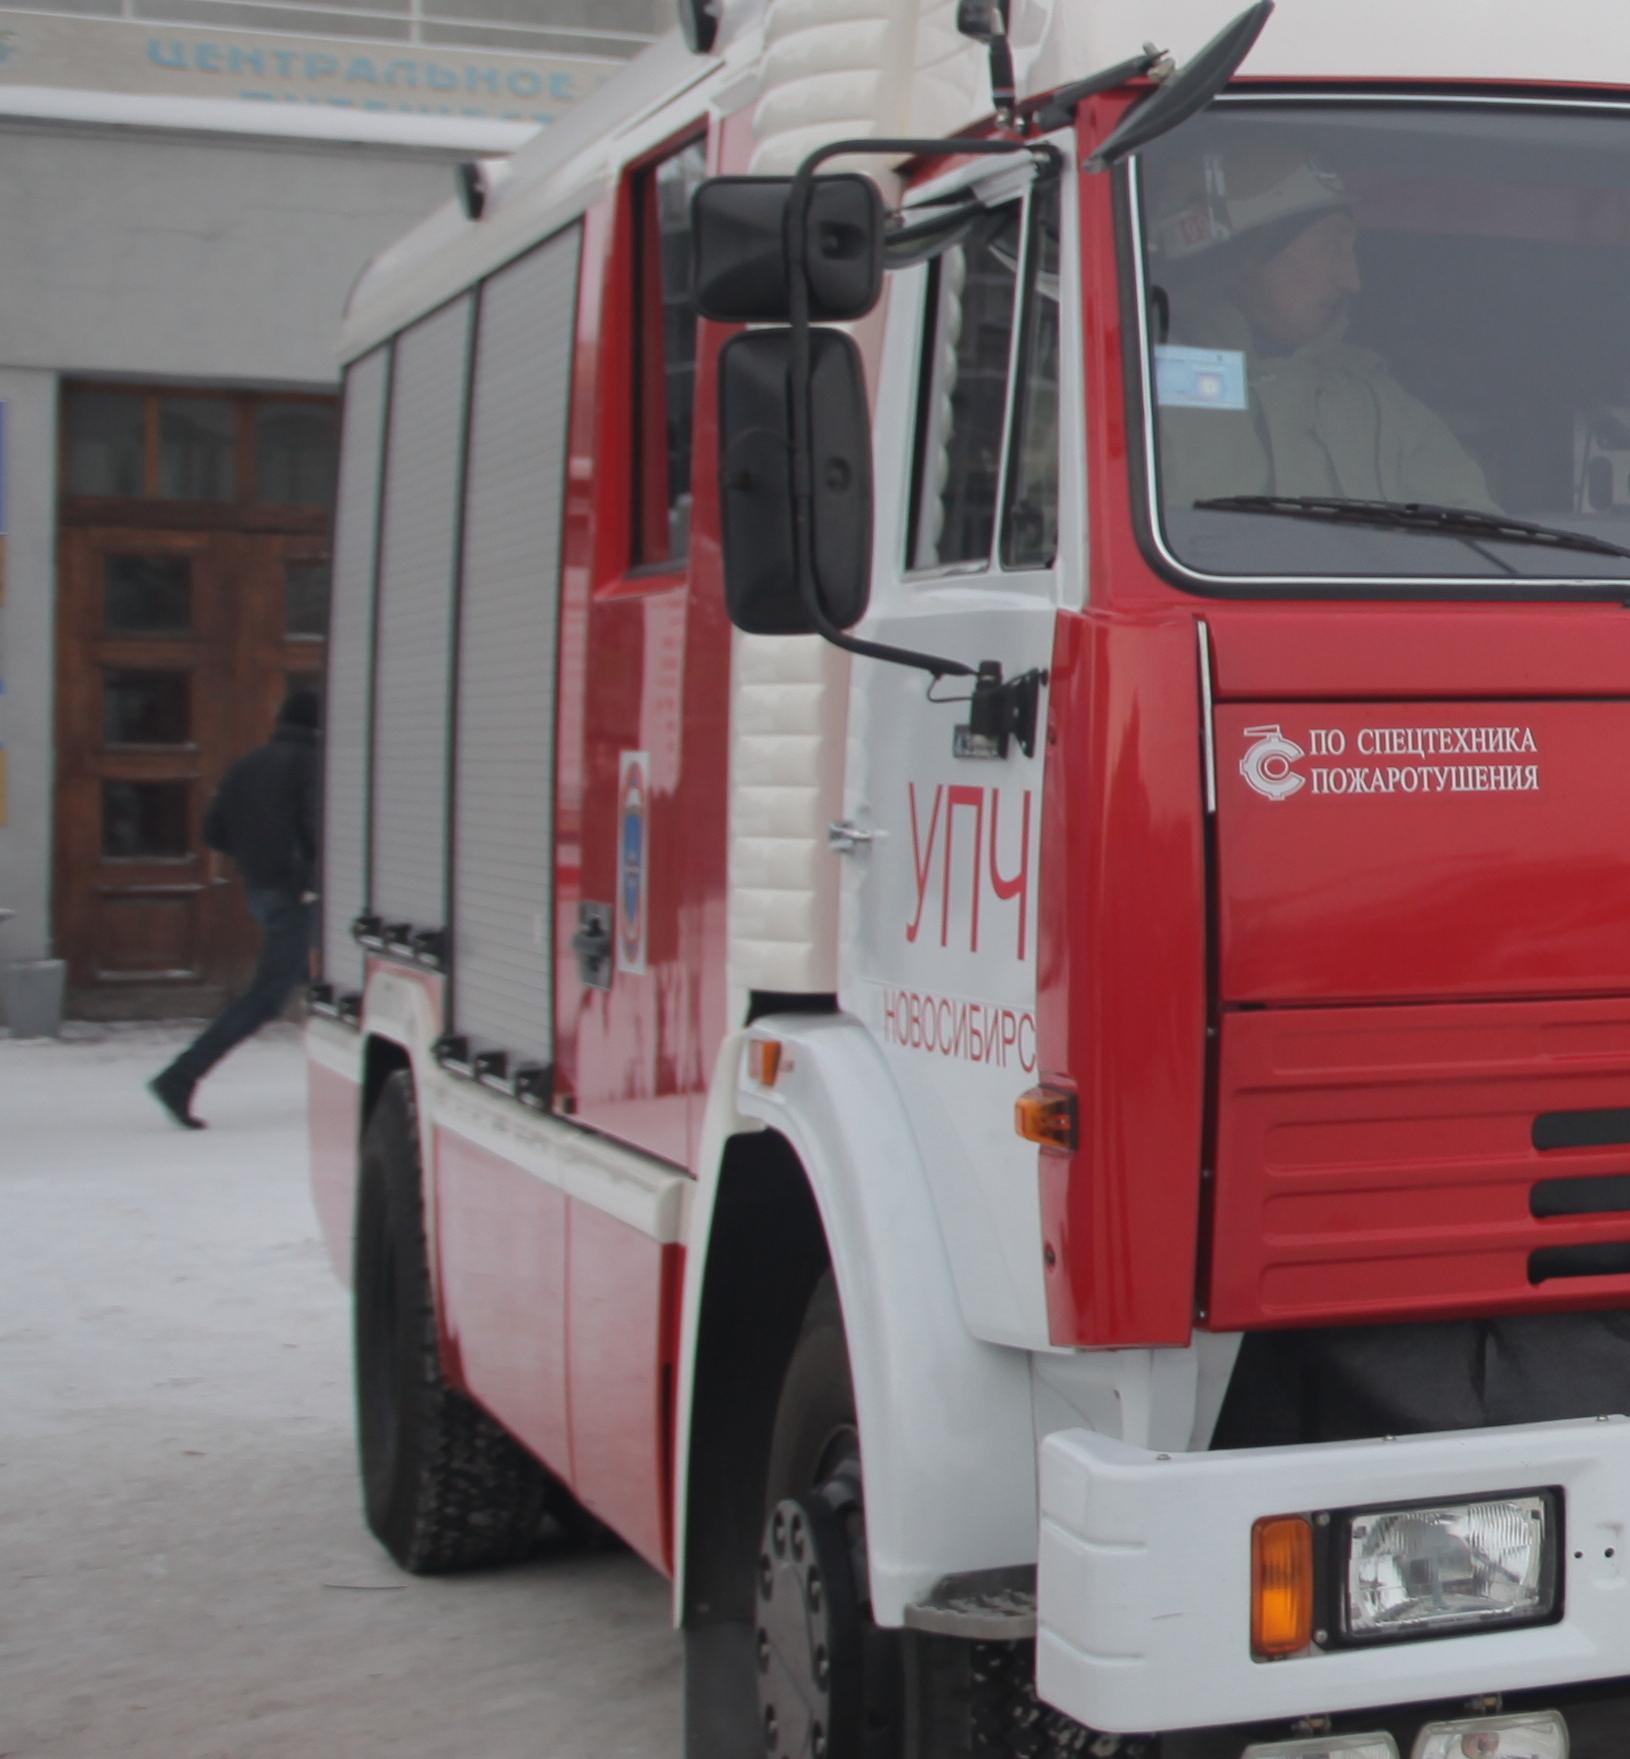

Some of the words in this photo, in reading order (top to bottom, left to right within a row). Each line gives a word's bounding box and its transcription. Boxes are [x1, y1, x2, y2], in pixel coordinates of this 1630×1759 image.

[146, 38, 575, 99] ЦЕНТРАЛЬНОЕ
[1309, 728, 1346, 755] ПО
[1356, 726, 1538, 759] СПЕЦТЕХНИКА
[1311, 764, 1539, 794] ПОЖАРОТУШЕНИЯ
[906, 782, 1032, 961] УПЧ
[884, 988, 1038, 1073] НОВОСИБИРС
